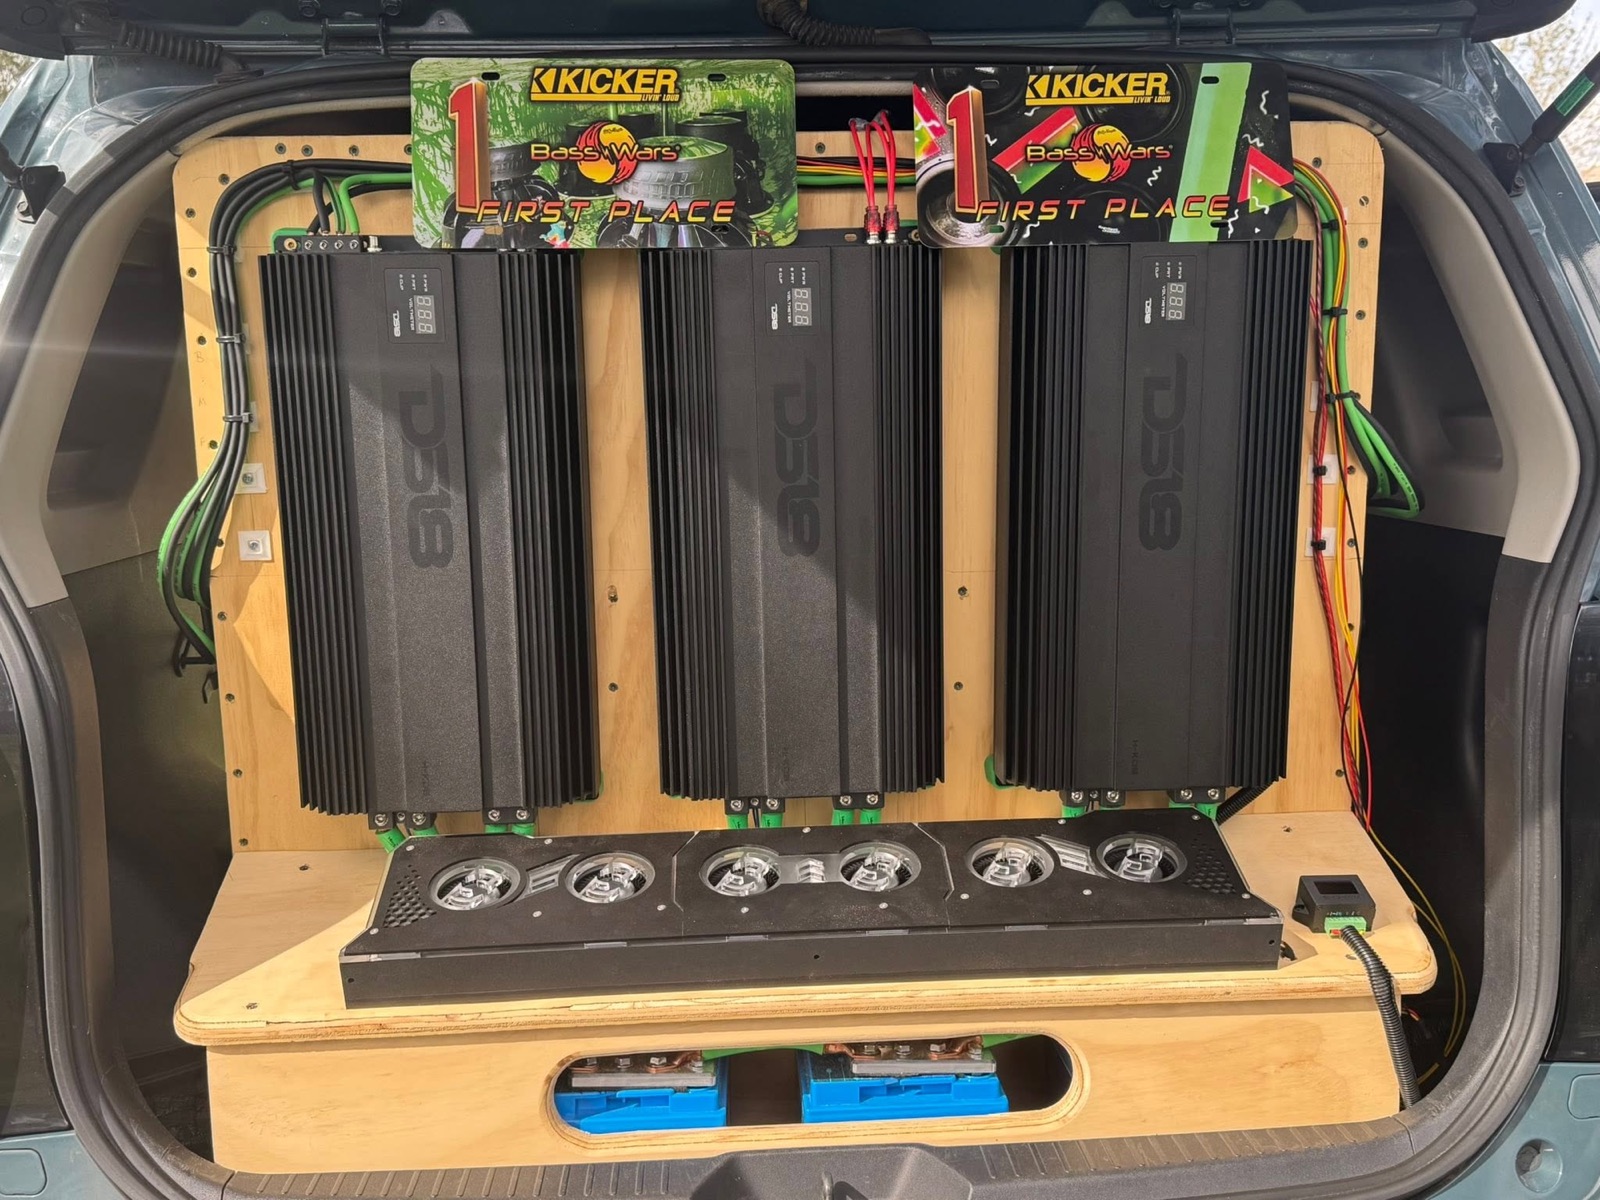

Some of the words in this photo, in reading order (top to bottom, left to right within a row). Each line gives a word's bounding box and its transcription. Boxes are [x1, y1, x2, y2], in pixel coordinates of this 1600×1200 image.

[556, 67, 678, 94] KICKER
[1050, 72, 1169, 96] KICKER
[662, 94, 680, 102] LOUD
[1153, 96, 1171, 104] LOUD
[448, 78, 490, 213] 1
[530, 142, 602, 163] Bass
[611, 142, 678, 162] Wars
[946, 85, 989, 214] 1
[1026, 145, 1097, 163] Bass
[1105, 144, 1171, 161] Wars
[476, 200, 592, 224] FIRST
[608, 200, 737, 224] PLACE
[976, 199, 1087, 222] FIRST
[1104, 195, 1231, 219] PLACE
[773, 357, 821, 557] DS18
[1138, 352, 1188, 551] DS18
[399, 363, 454, 569] DS18
